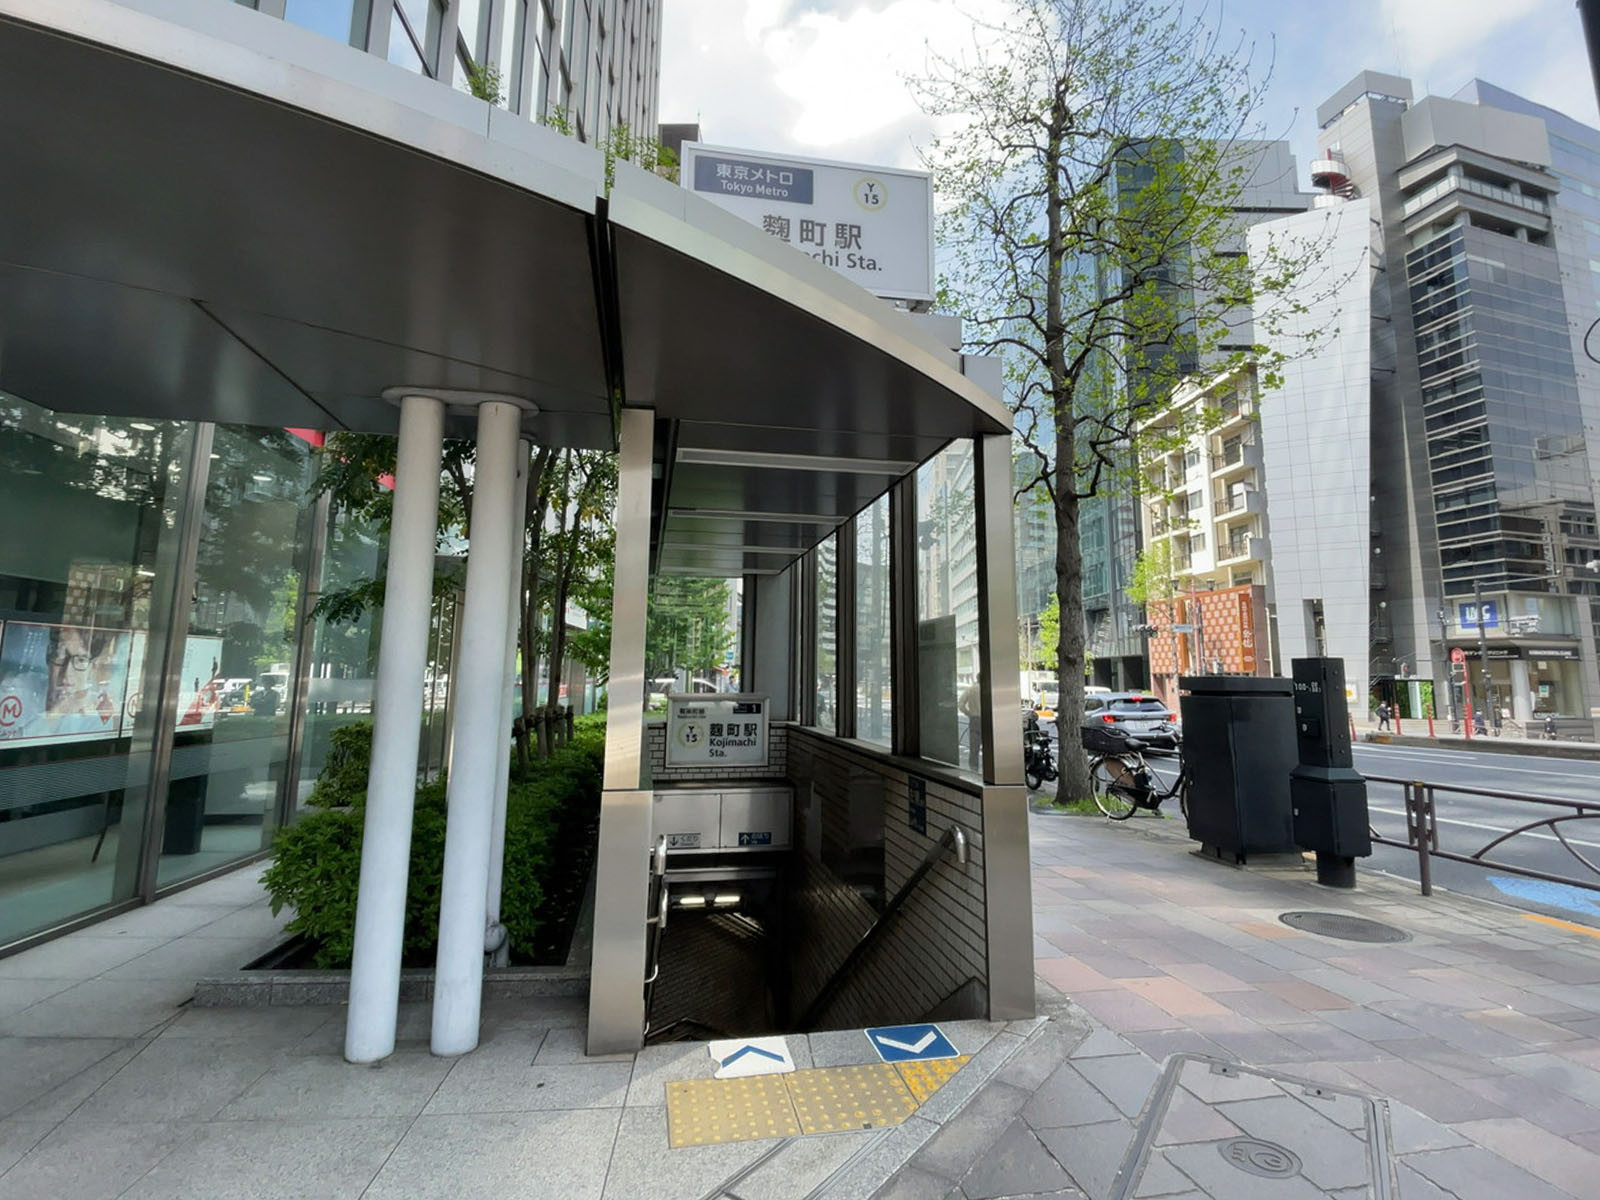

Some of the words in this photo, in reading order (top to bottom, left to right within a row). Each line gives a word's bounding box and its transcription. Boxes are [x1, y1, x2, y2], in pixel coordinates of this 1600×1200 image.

[715, 162, 794, 186] 東京メトロ
[720, 180, 754, 195] Tokyo
[756, 184, 789, 198] Metro
[866, 182, 874, 193] Y
[863, 193, 880, 206] 15
[846, 252, 883, 272] Sta.
[687, 725, 695, 734] Y
[685, 733, 698, 743] 15
[709, 737, 757, 749] Kojimachi
[709, 748, 728, 757] Sta.
